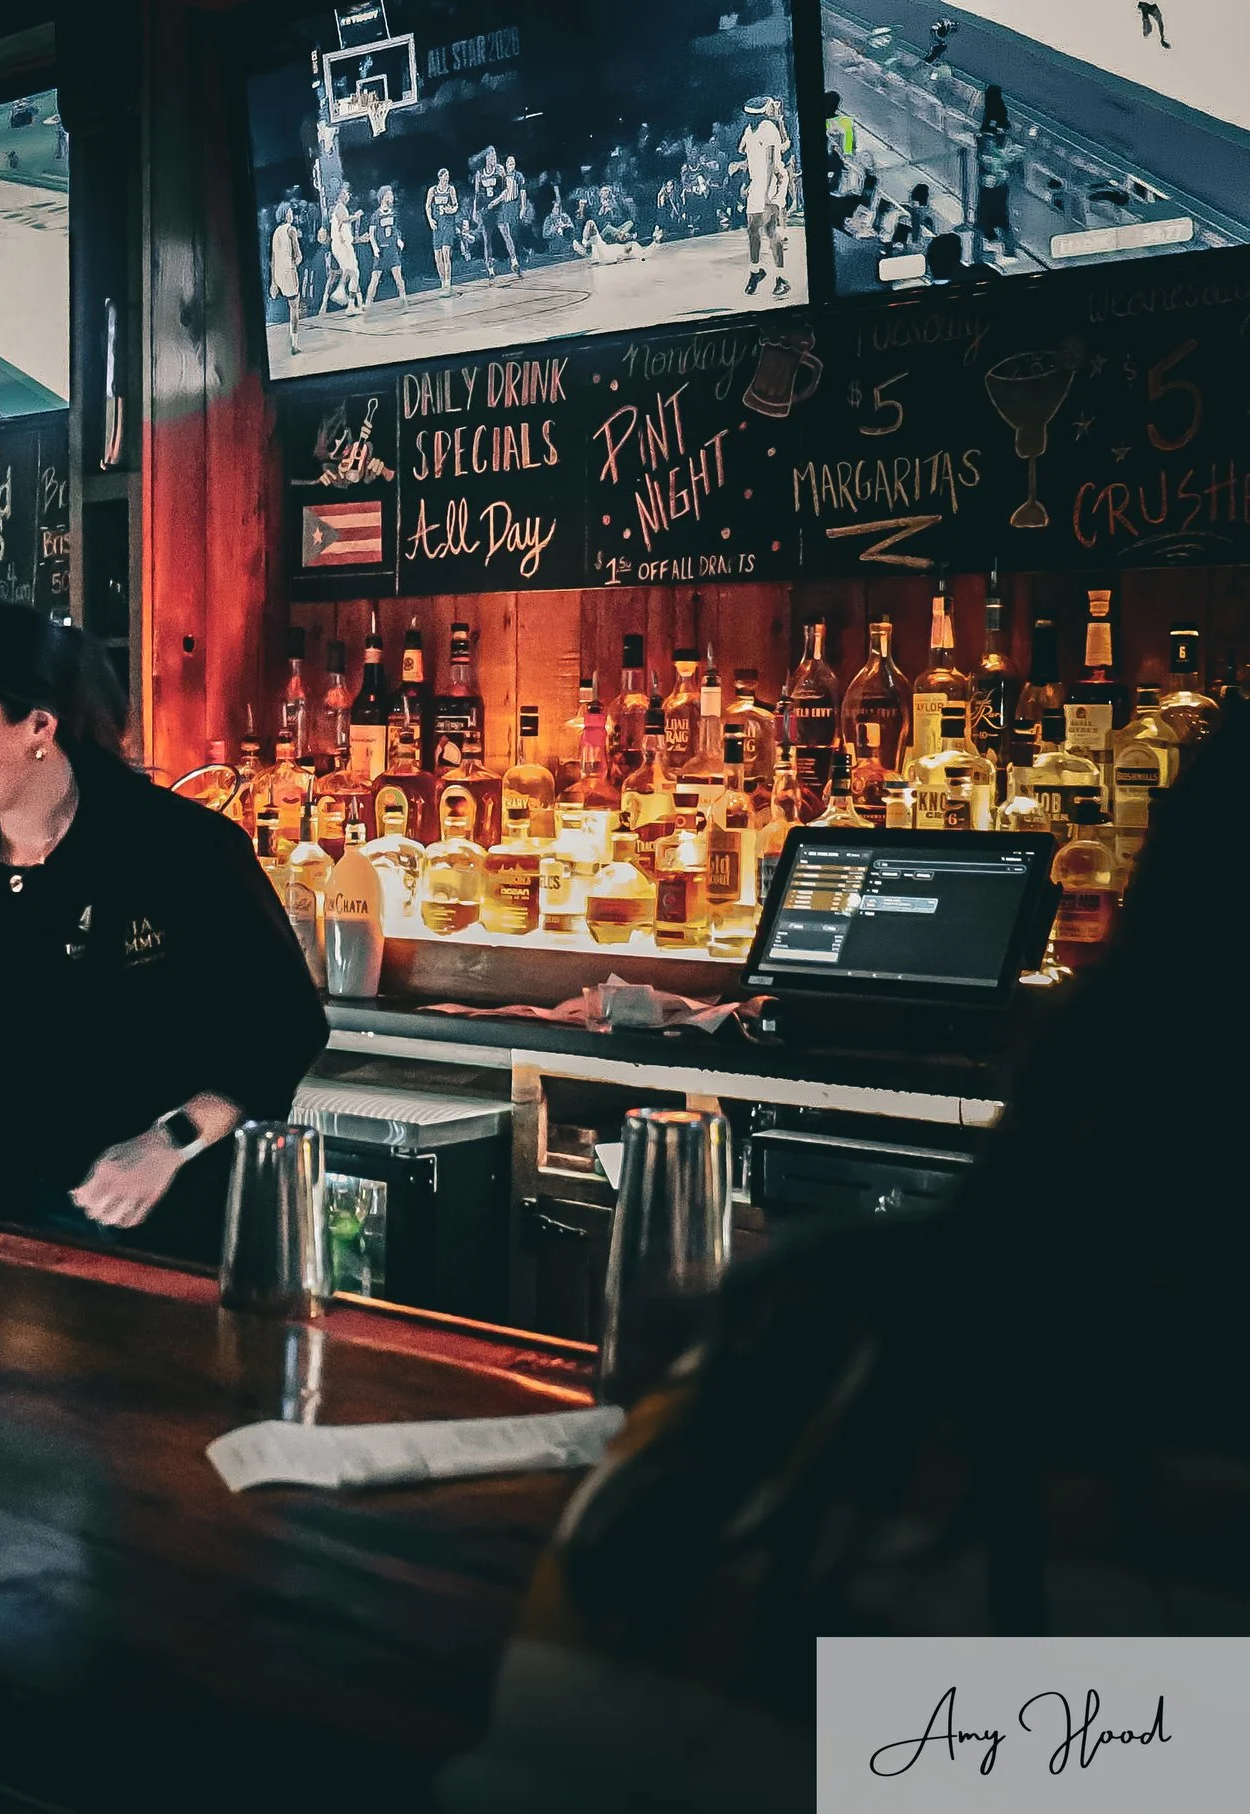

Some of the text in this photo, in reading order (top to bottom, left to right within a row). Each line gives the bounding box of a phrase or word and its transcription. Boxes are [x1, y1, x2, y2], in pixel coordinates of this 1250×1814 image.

[403, 357, 568, 419] DAILY DRINK
[413, 420, 558, 480] SPECIALS
[593, 381, 690, 484] PINT
[635, 429, 729, 552] NIGHT
[793, 449, 981, 516] MARGARITAS
[405, 498, 557, 578] All Day
[638, 559, 669, 581] OFF
[671, 556, 694, 580] ALL
[699, 553, 756, 577] DRATS
[665, 729, 689, 744] RAIG
[919, 791, 946, 811] KNO
